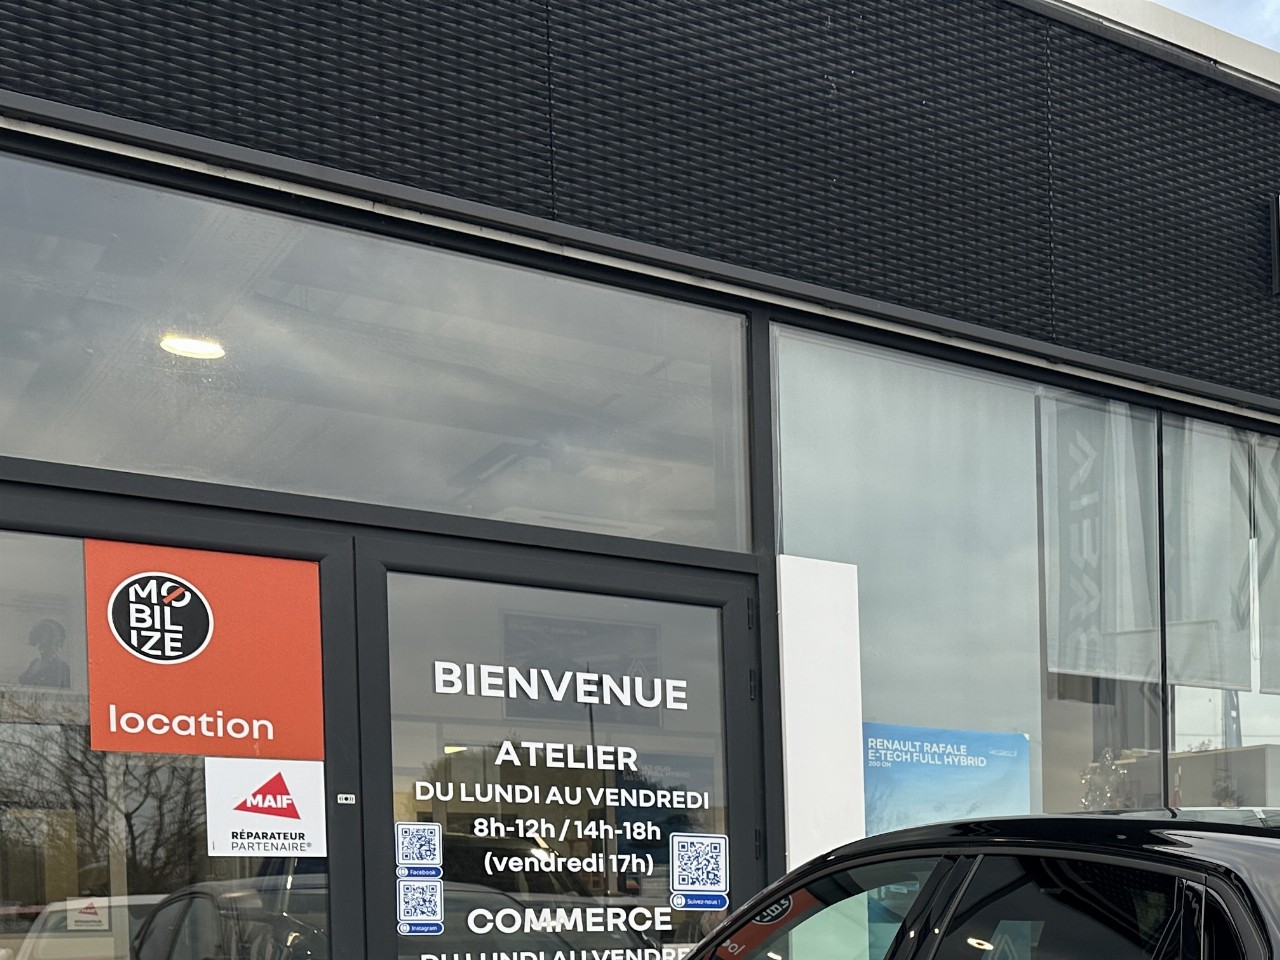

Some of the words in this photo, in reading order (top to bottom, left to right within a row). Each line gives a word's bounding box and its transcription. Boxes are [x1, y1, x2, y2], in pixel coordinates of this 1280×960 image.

[434, 661, 688, 710] BIENVENUE
[108, 704, 274, 740] location
[494, 740, 638, 772] ATELIER
[868, 738, 921, 751] RENAULT
[923, 742, 967, 755] RAFALE
[868, 749, 911, 763] E-TECH
[913, 753, 942, 765] FULL
[944, 755, 987, 767] HYBRID
[246, 794, 293, 810] MAIF
[415, 781, 454, 801] DU
[460, 783, 540, 804] LUNDI
[546, 787, 582, 805] AU
[586, 788, 709, 809] VENDREDI
[231, 829, 306, 841] RÉPARATEUR
[473, 817, 555, 838] 8h-12h
[574, 820, 661, 841] 14h-18h
[484, 851, 604, 876] (vendredi
[609, 854, 654, 877] 17h)
[411, 925, 438, 933] Instagram
[467, 907, 673, 934] COMMERCE
